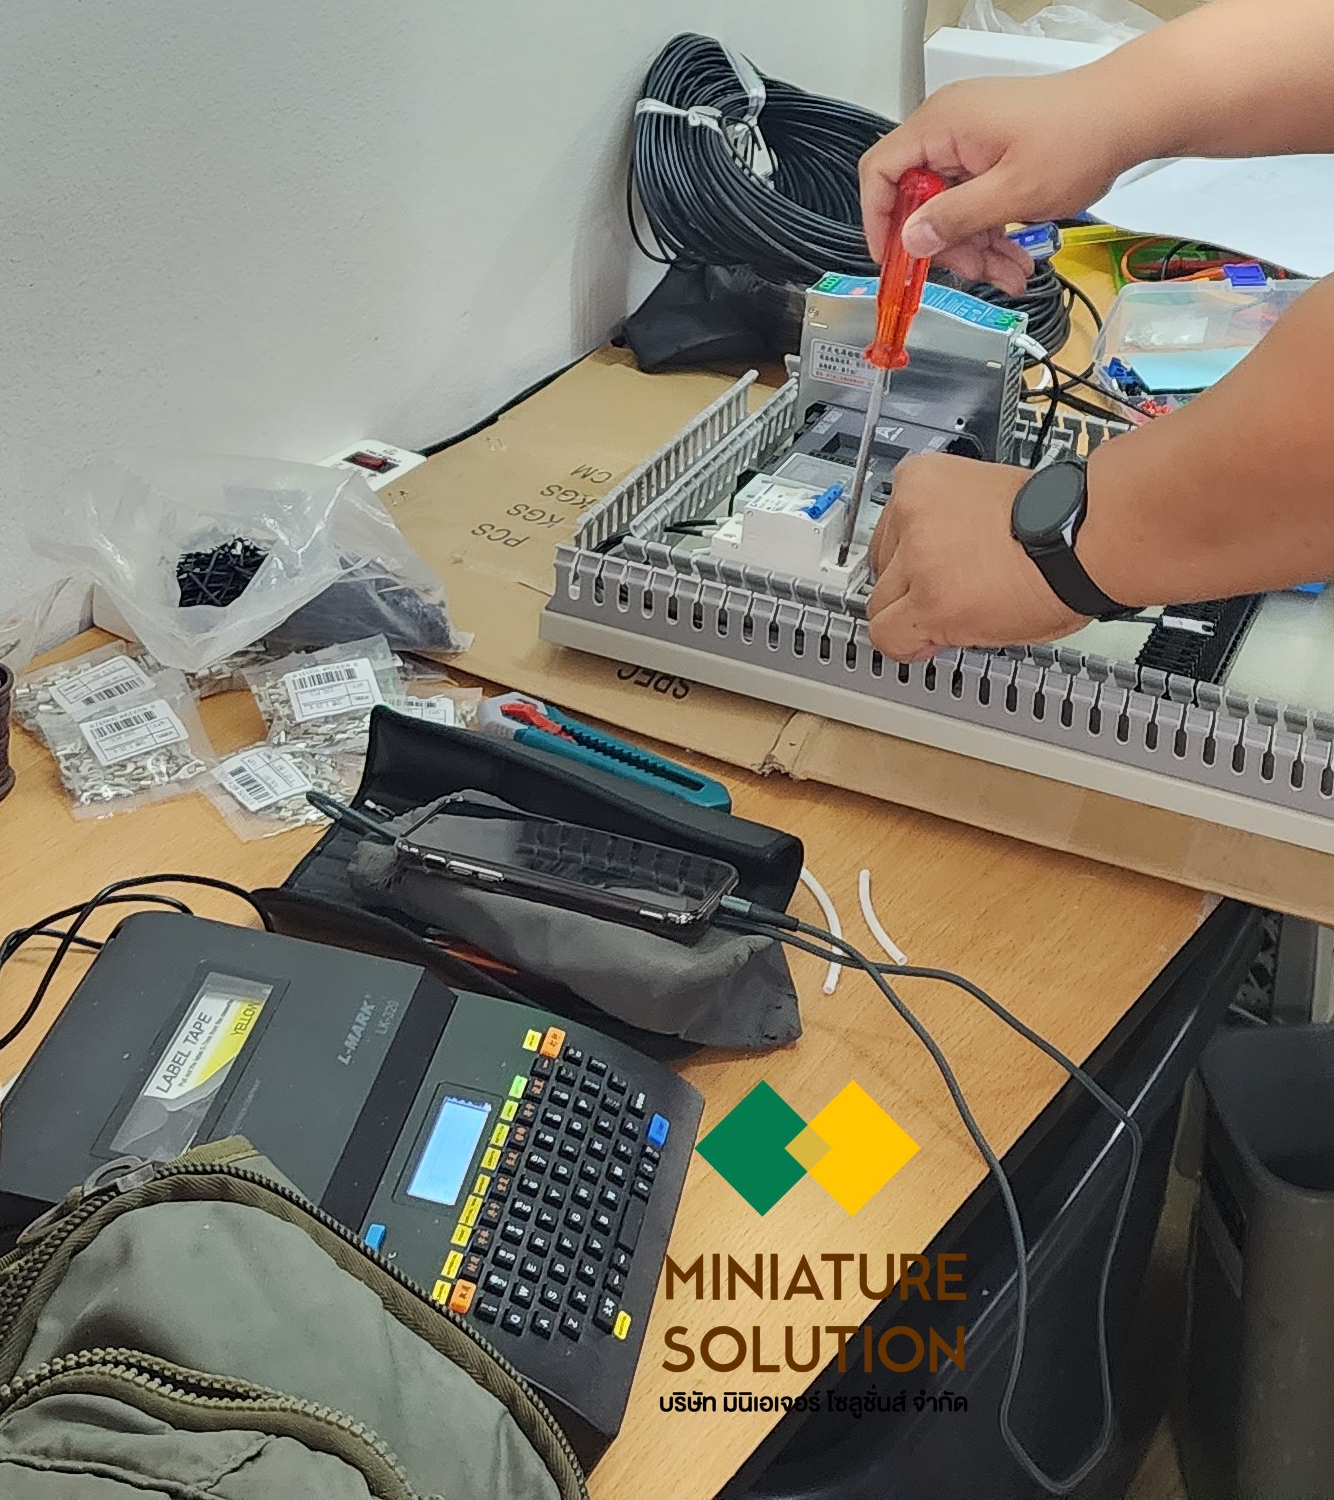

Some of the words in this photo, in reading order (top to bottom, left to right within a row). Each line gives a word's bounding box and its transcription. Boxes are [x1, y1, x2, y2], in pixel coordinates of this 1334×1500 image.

[570, 463, 613, 484] CM
[540, 484, 598, 509] KGS
[506, 503, 565, 529] KGS
[470, 522, 530, 548] PCS
[230, 1000, 262, 1037] YELLOW
[338, 1000, 376, 1066] L-MARK
[156, 1049, 192, 1093] LABEL
[183, 1012, 212, 1045] TAPE
